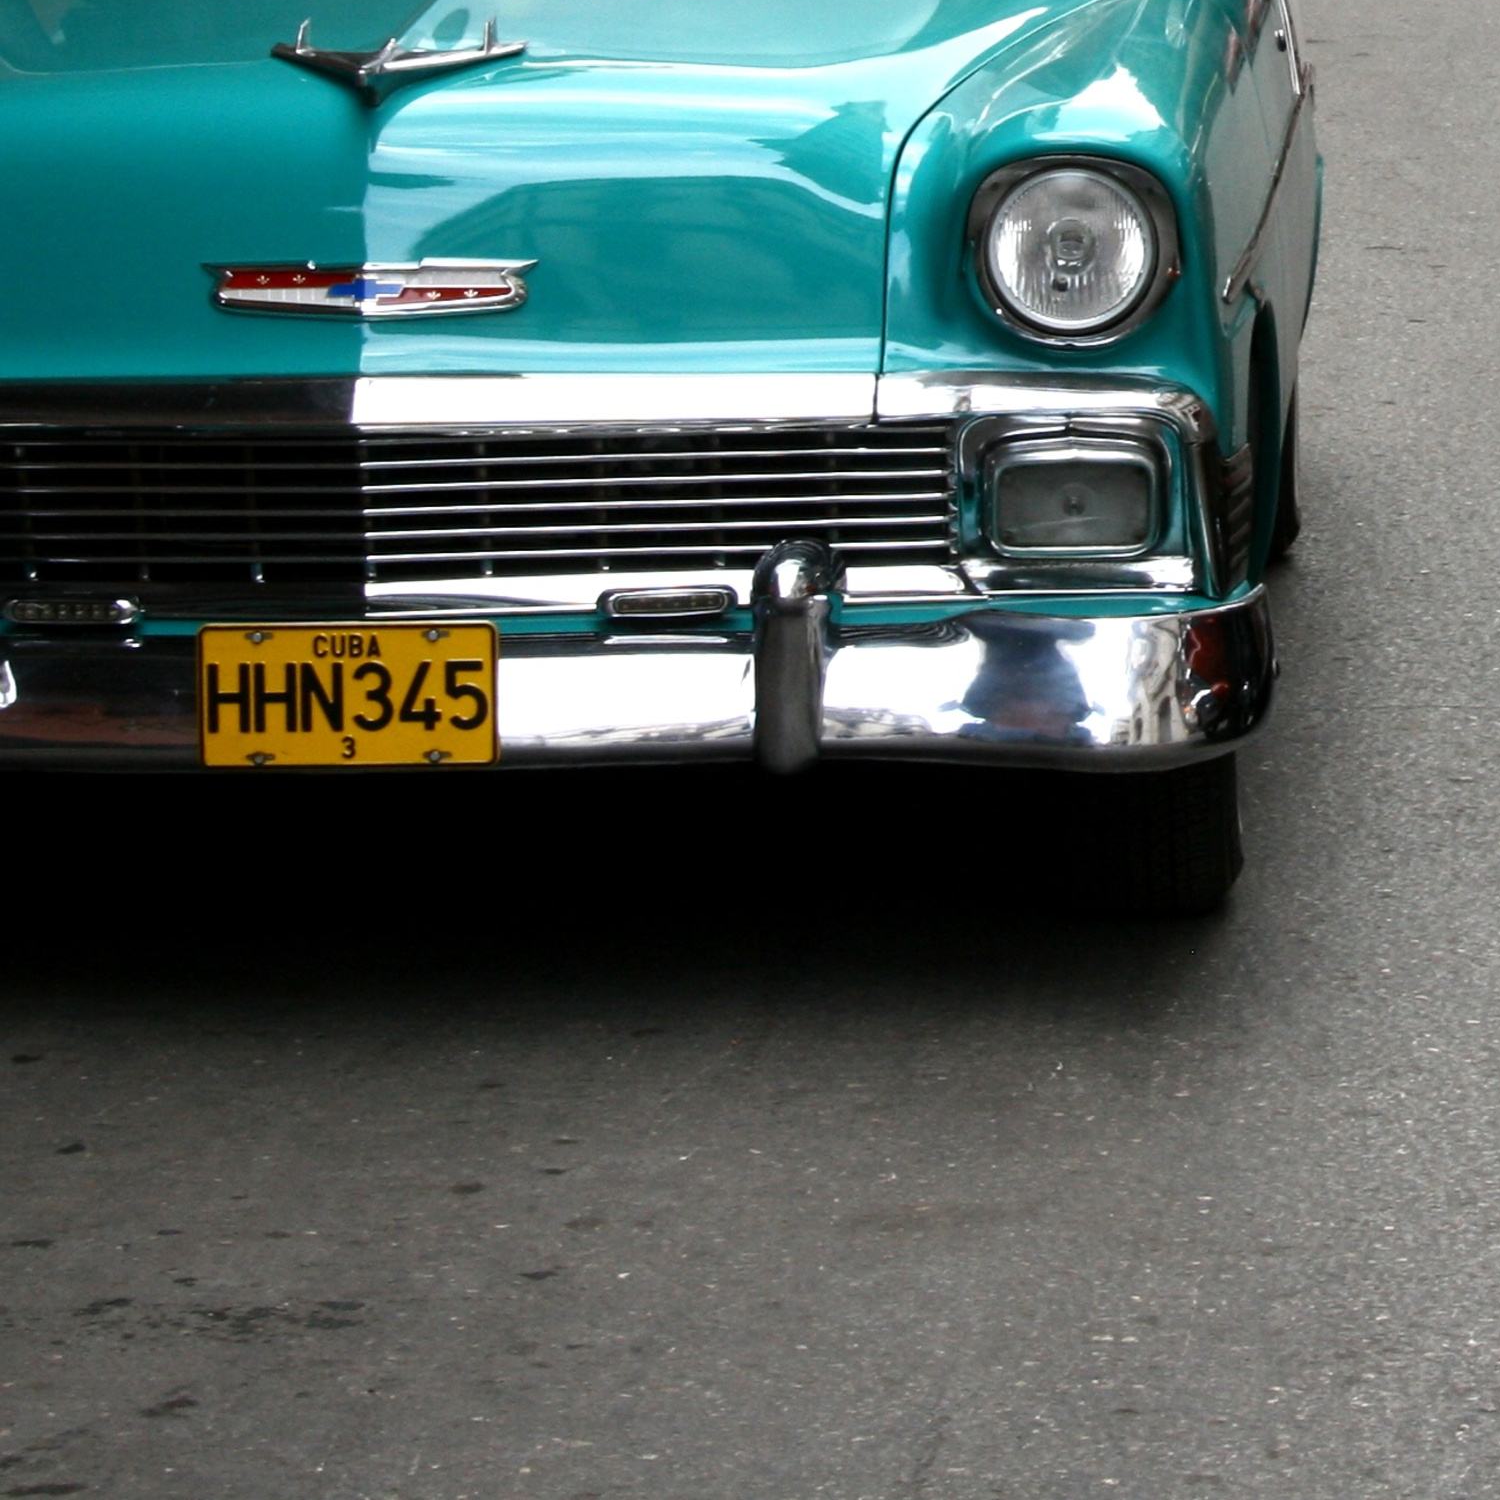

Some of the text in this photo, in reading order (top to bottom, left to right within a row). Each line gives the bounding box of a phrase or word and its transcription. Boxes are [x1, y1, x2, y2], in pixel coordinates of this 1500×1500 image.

[312, 633, 381, 658] CUBA
[206, 660, 489, 733] HHN345
[341, 735, 356, 759] 3
